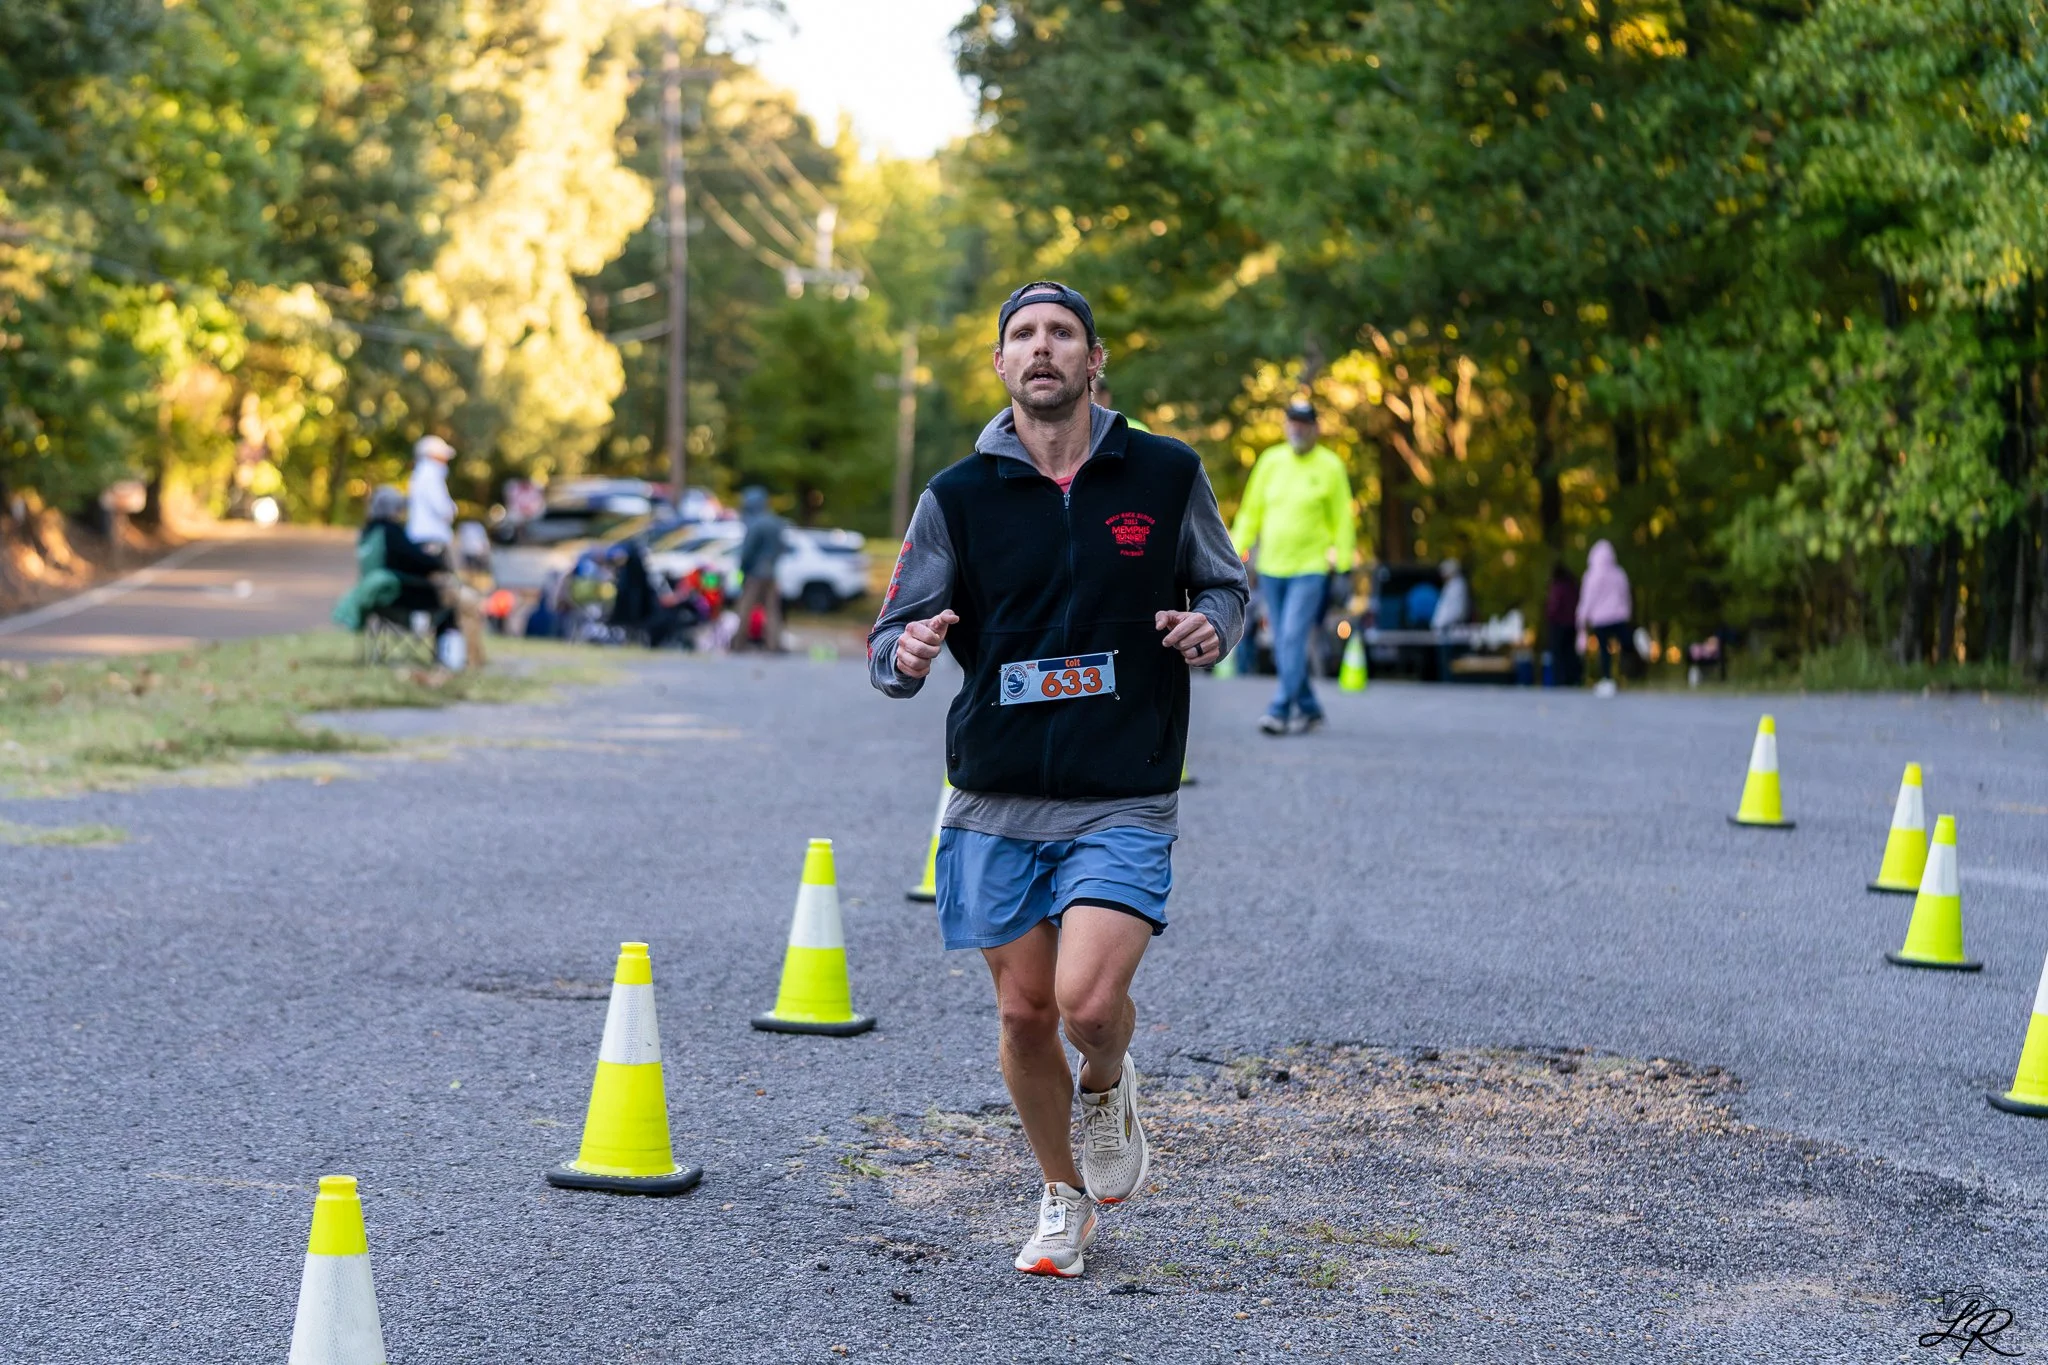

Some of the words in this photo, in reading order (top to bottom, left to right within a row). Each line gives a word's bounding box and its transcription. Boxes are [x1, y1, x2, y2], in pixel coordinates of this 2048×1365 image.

[1111, 526, 1150, 534] MEMPHIS
[1065, 658, 1081, 668] Colt
[1041, 667, 1103, 698] 633
